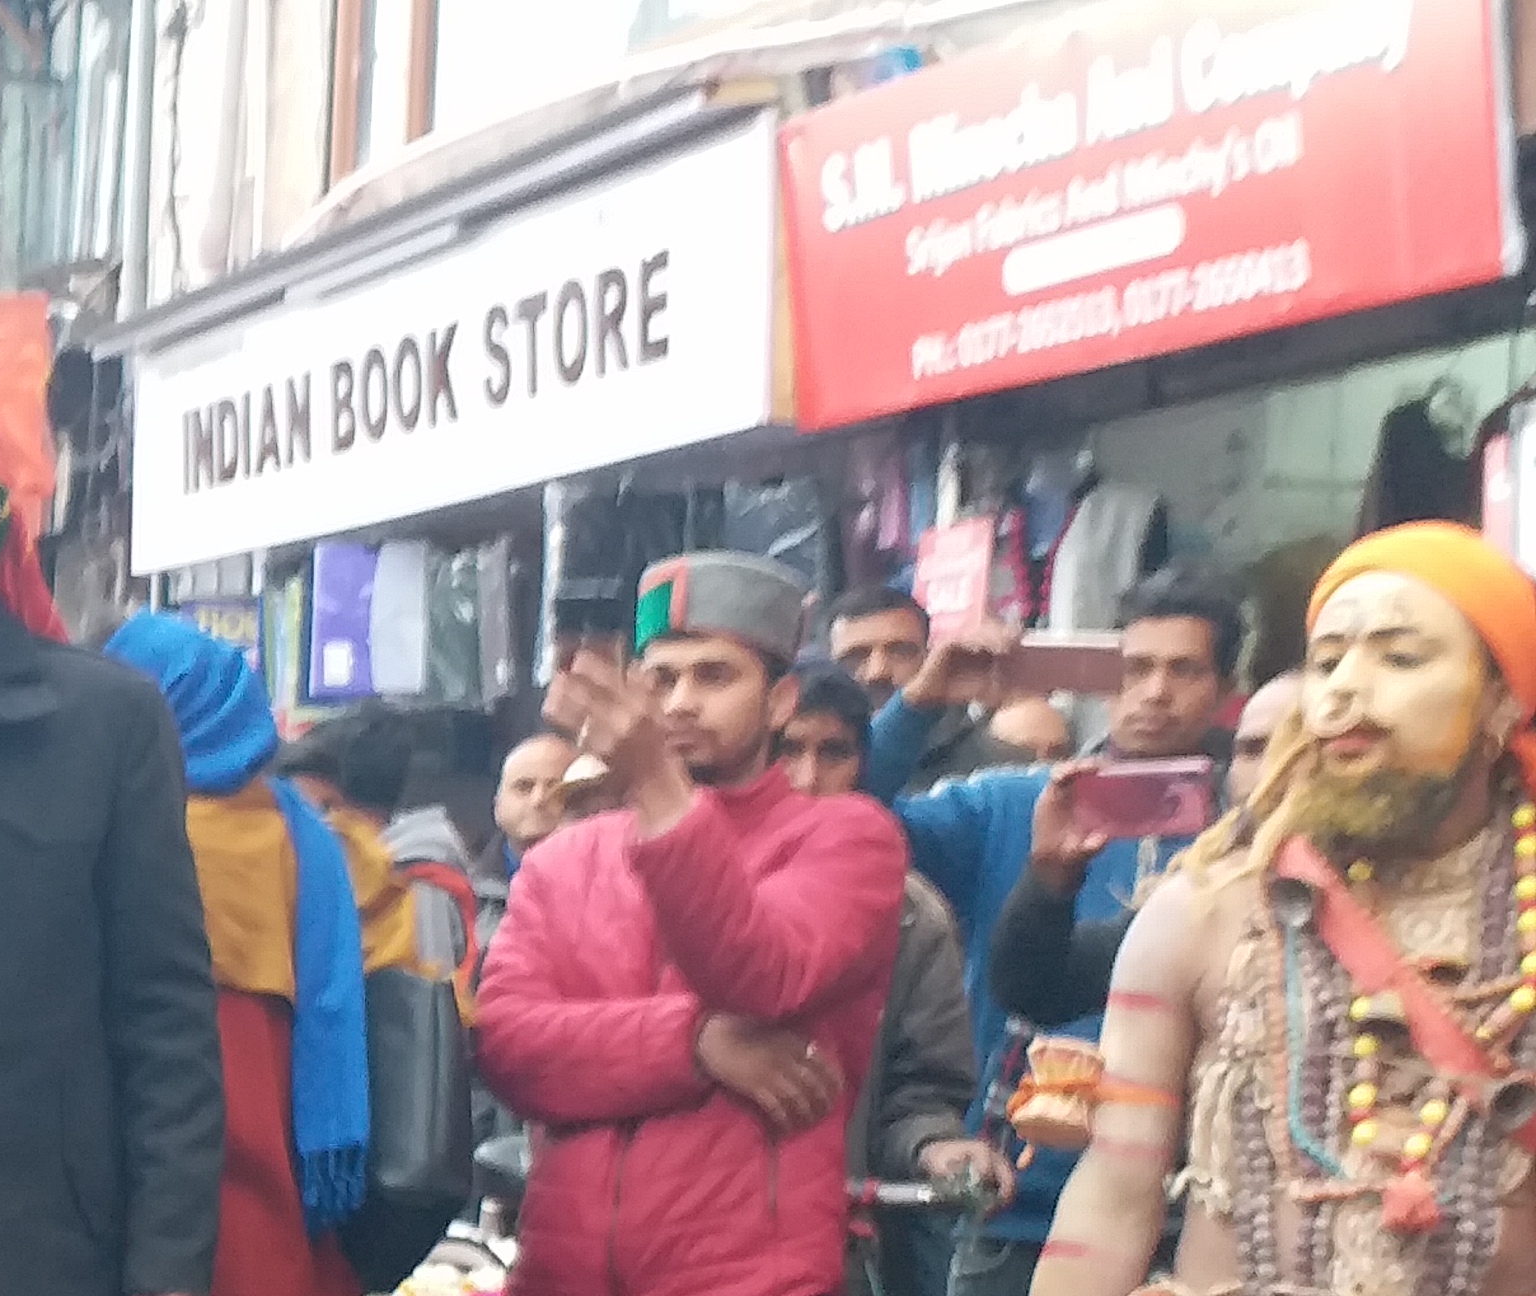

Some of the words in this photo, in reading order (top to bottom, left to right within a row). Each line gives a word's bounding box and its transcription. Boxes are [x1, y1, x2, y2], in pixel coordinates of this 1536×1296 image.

[1086, 33, 1174, 146] And
[181, 369, 312, 496] INDIAN
[329, 319, 460, 456] BOOK
[482, 247, 671, 408] STORE
